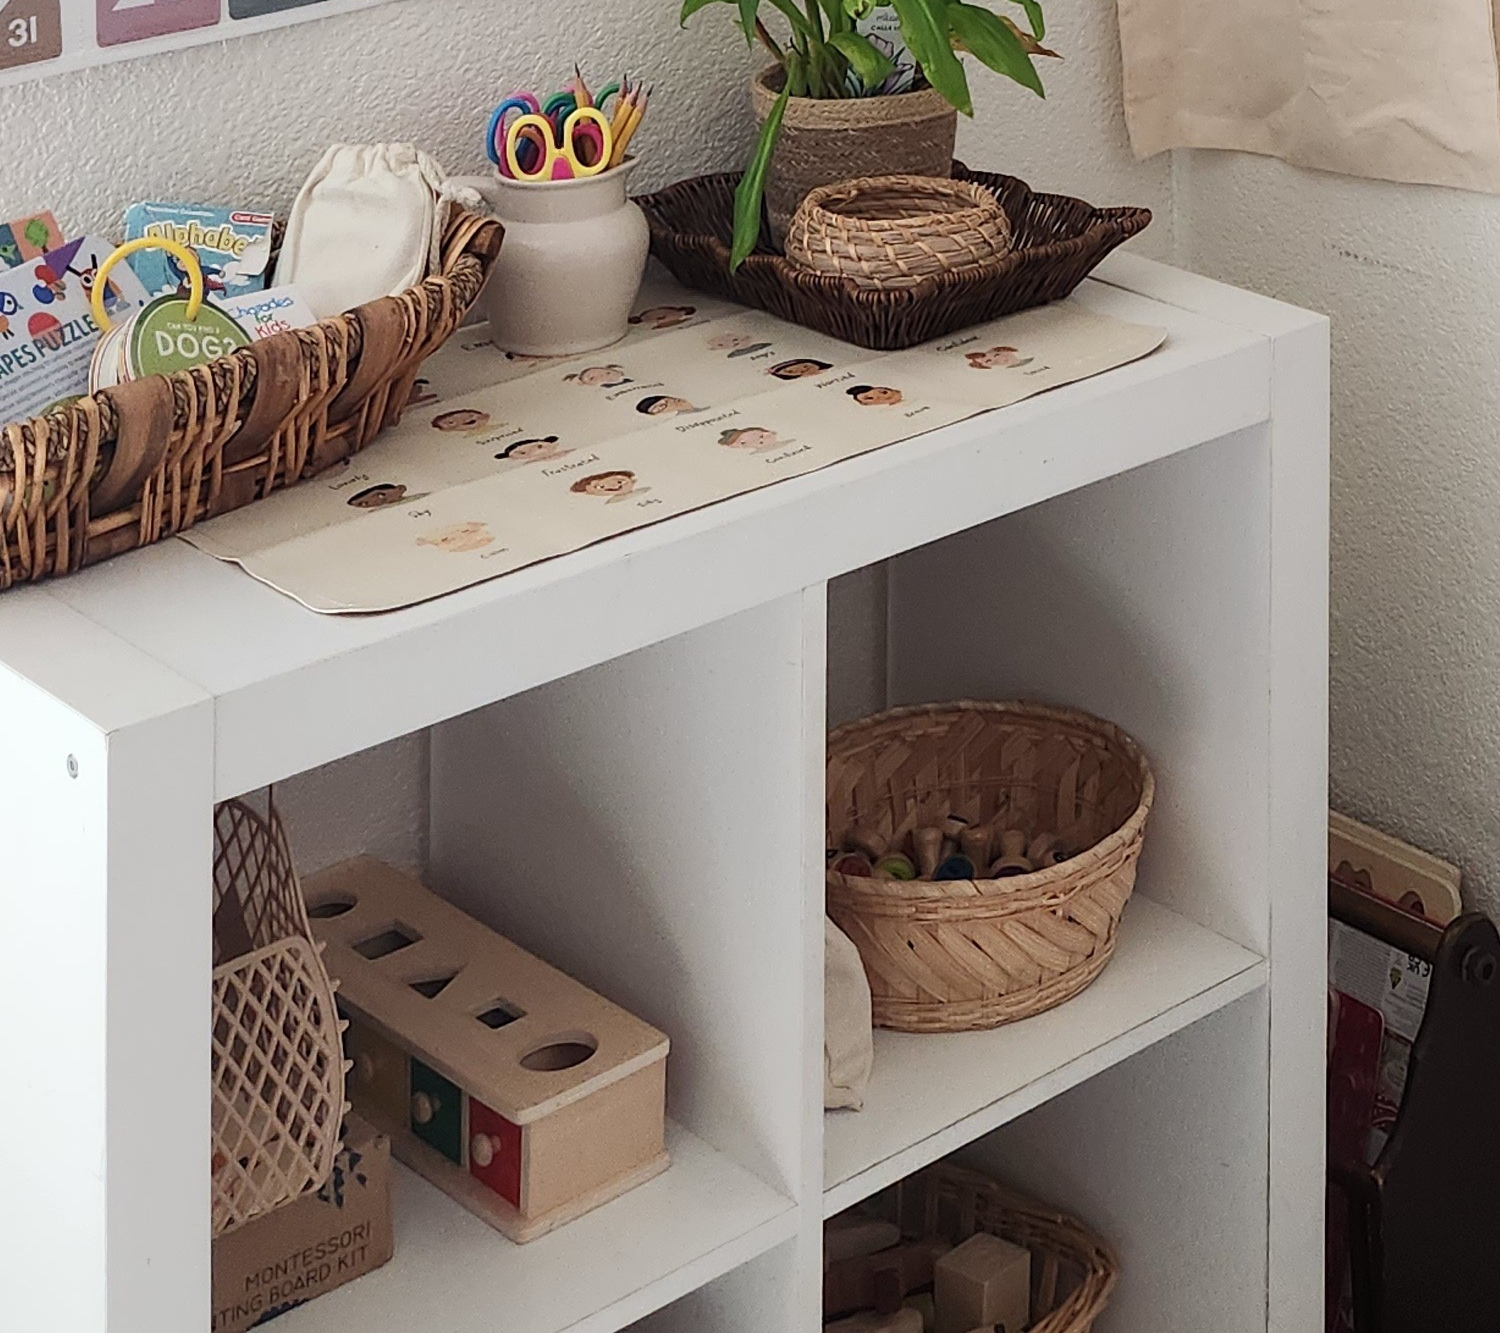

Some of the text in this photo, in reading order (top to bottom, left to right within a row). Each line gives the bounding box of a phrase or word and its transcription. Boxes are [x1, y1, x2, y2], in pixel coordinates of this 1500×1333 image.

[32, 314, 99, 358] PUZZLE
[255, 313, 273, 323] for
[245, 1220, 371, 1292] MONTESSORI
[269, 1244, 369, 1303] BOARD KIT
